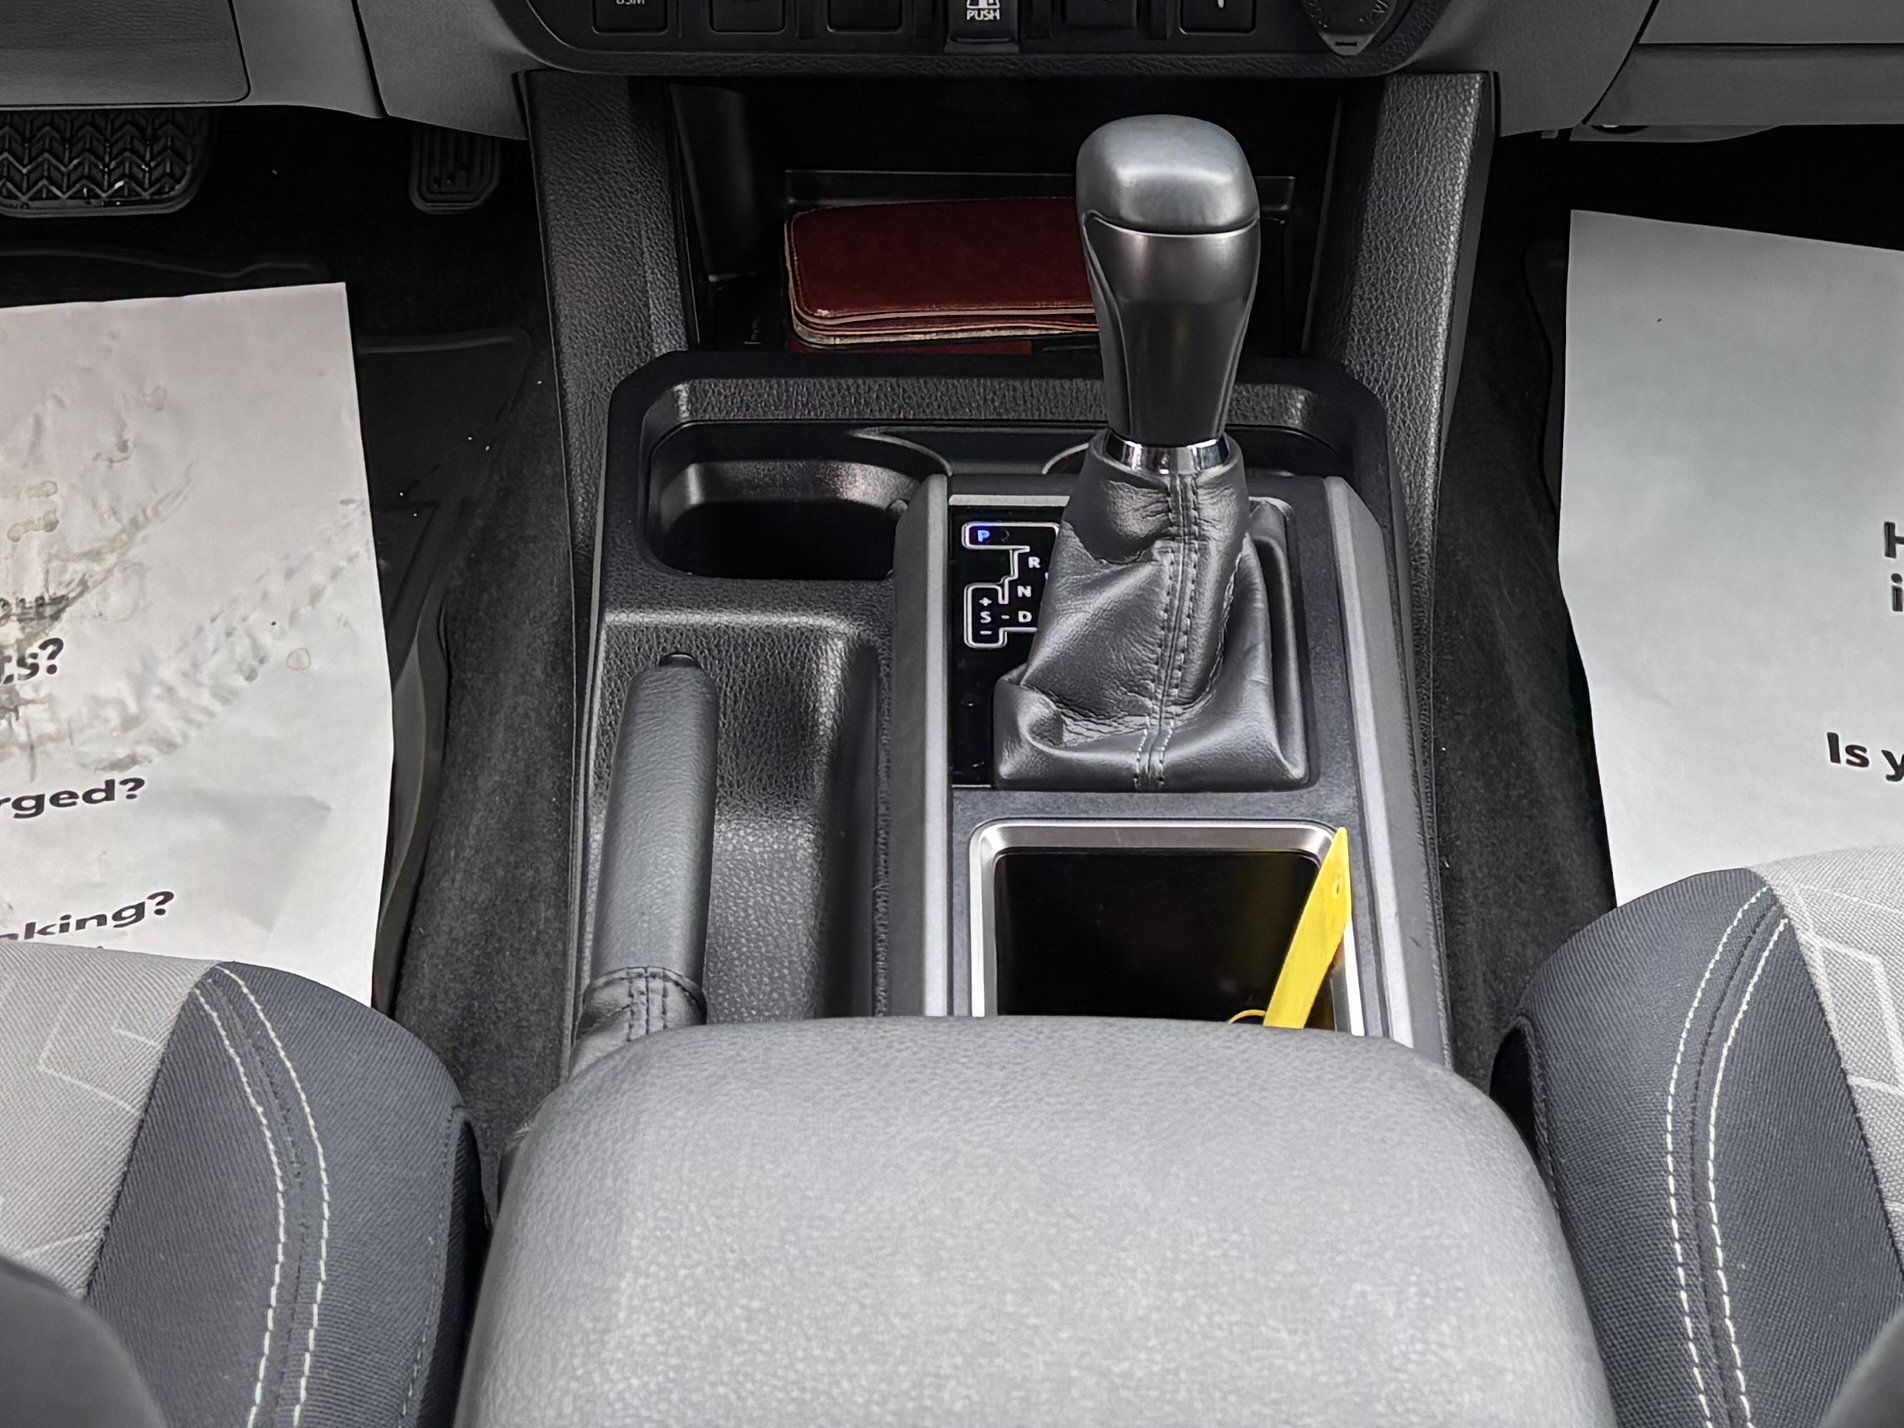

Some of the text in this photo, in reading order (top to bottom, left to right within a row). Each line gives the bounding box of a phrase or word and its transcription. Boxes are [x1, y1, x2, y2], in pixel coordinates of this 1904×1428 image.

[966, 8, 1001, 22] PUSH
[977, 529, 991, 543] P
[1028, 556, 1042, 569] R
[1017, 585, 1032, 598] N
[980, 610, 1033, 624] S D
[1826, 731, 1870, 768] Is
